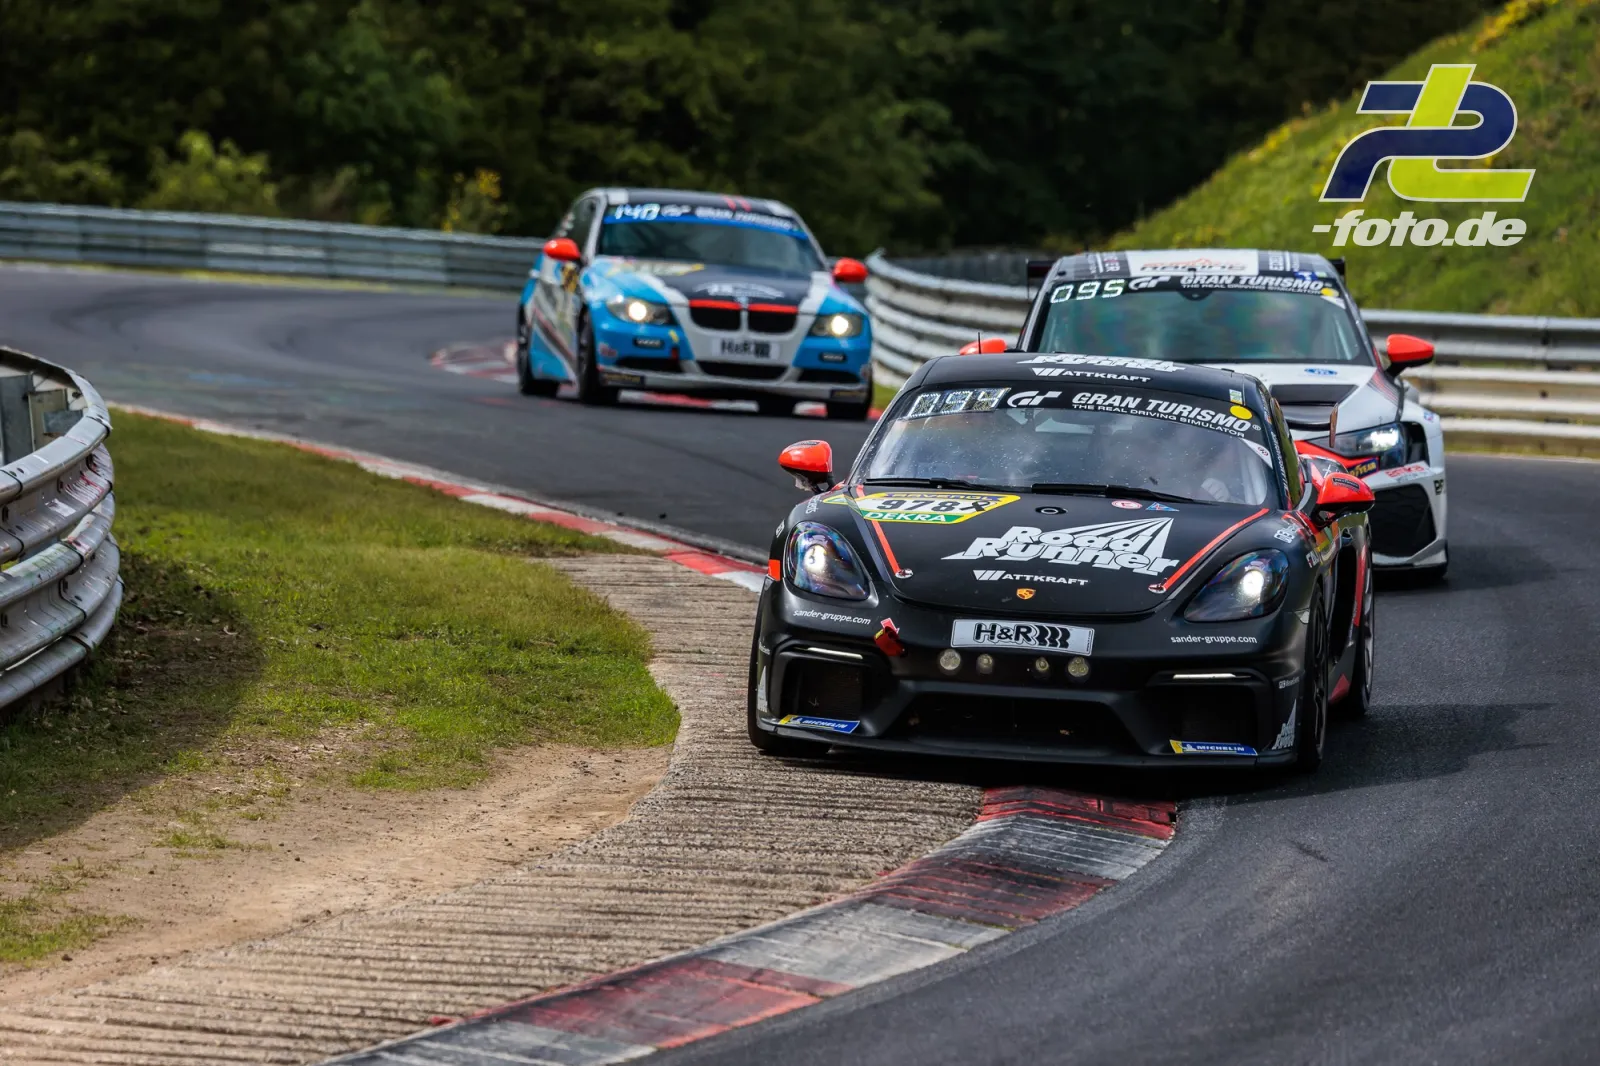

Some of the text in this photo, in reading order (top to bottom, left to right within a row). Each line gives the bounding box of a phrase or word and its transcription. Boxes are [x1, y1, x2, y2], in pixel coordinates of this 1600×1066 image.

[1050, 279, 1127, 304] 095
[1180, 274, 1234, 286] GRAN
[1239, 275, 1324, 292] TURISMO
[1072, 392, 1142, 409] GRAN
[1097, 405, 1127, 414] REAL
[1130, 408, 1177, 421] DRIVING
[1179, 416, 1246, 438] SIMULATOR
[876, 498, 961, 513] 978
[866, 511, 947, 522] DEKRA
[1000, 524, 1150, 553] Road
[942, 536, 1180, 576] Runner
[792, 608, 871, 626] sander-gruppe.com
[973, 622, 1036, 645] H&R
[1170, 634, 1258, 645] sander-gruppe.com
[1196, 744, 1246, 752] MICHELIN
